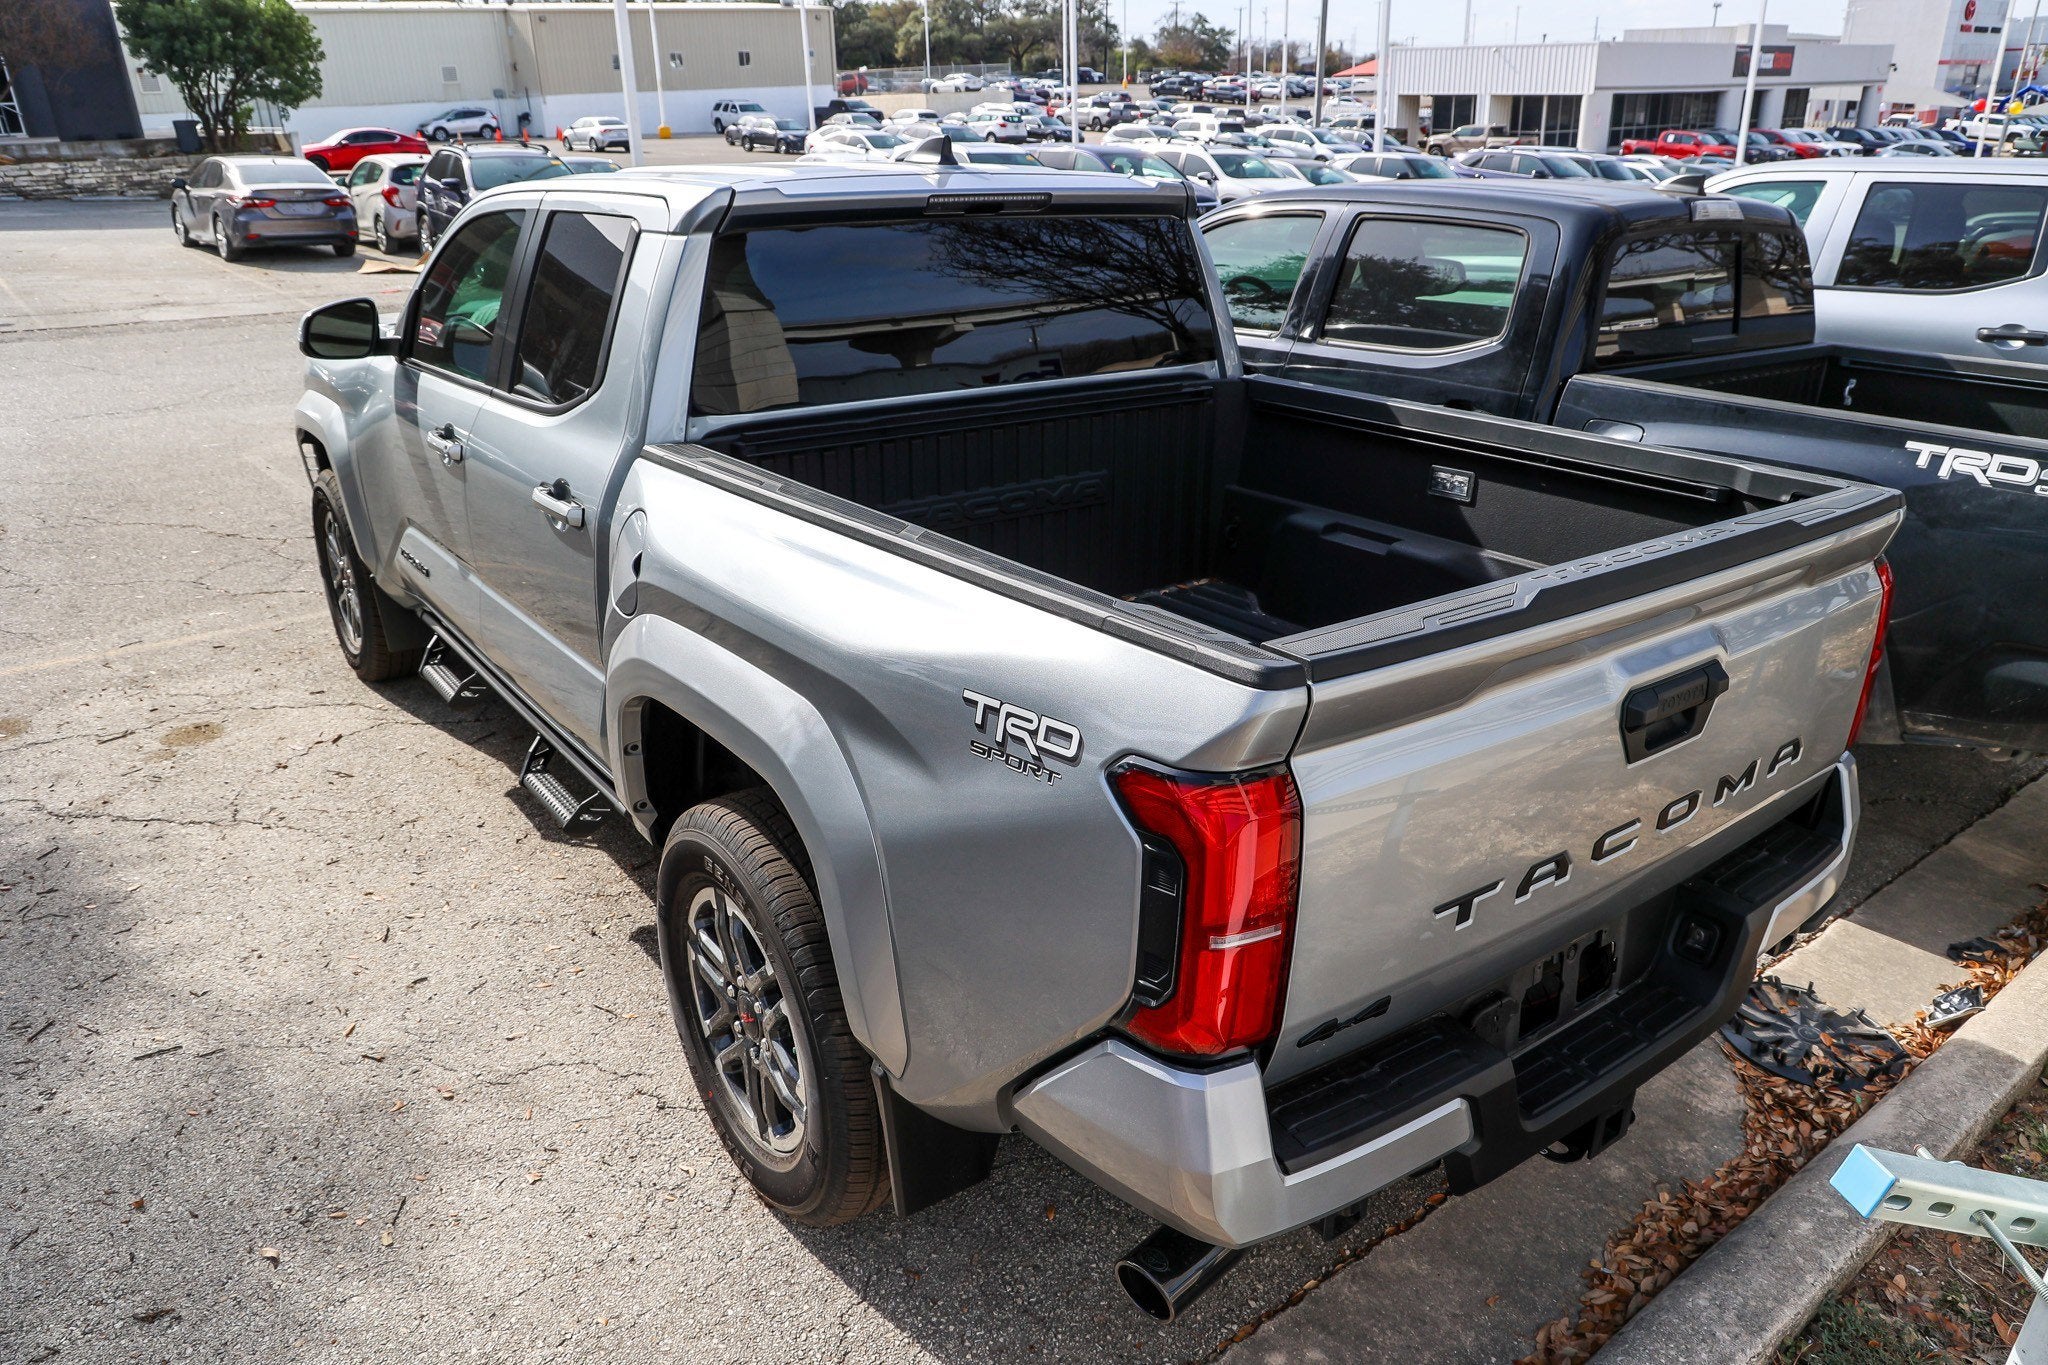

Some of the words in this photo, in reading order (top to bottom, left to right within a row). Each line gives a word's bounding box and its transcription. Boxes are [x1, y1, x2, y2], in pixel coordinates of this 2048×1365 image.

[1904, 440, 2041, 488] TRD
[1529, 526, 1737, 580] TACOMA
[962, 687, 1083, 768] TRD
[969, 739, 1062, 786] SPORT
[1433, 736, 1804, 931] TACOMA
